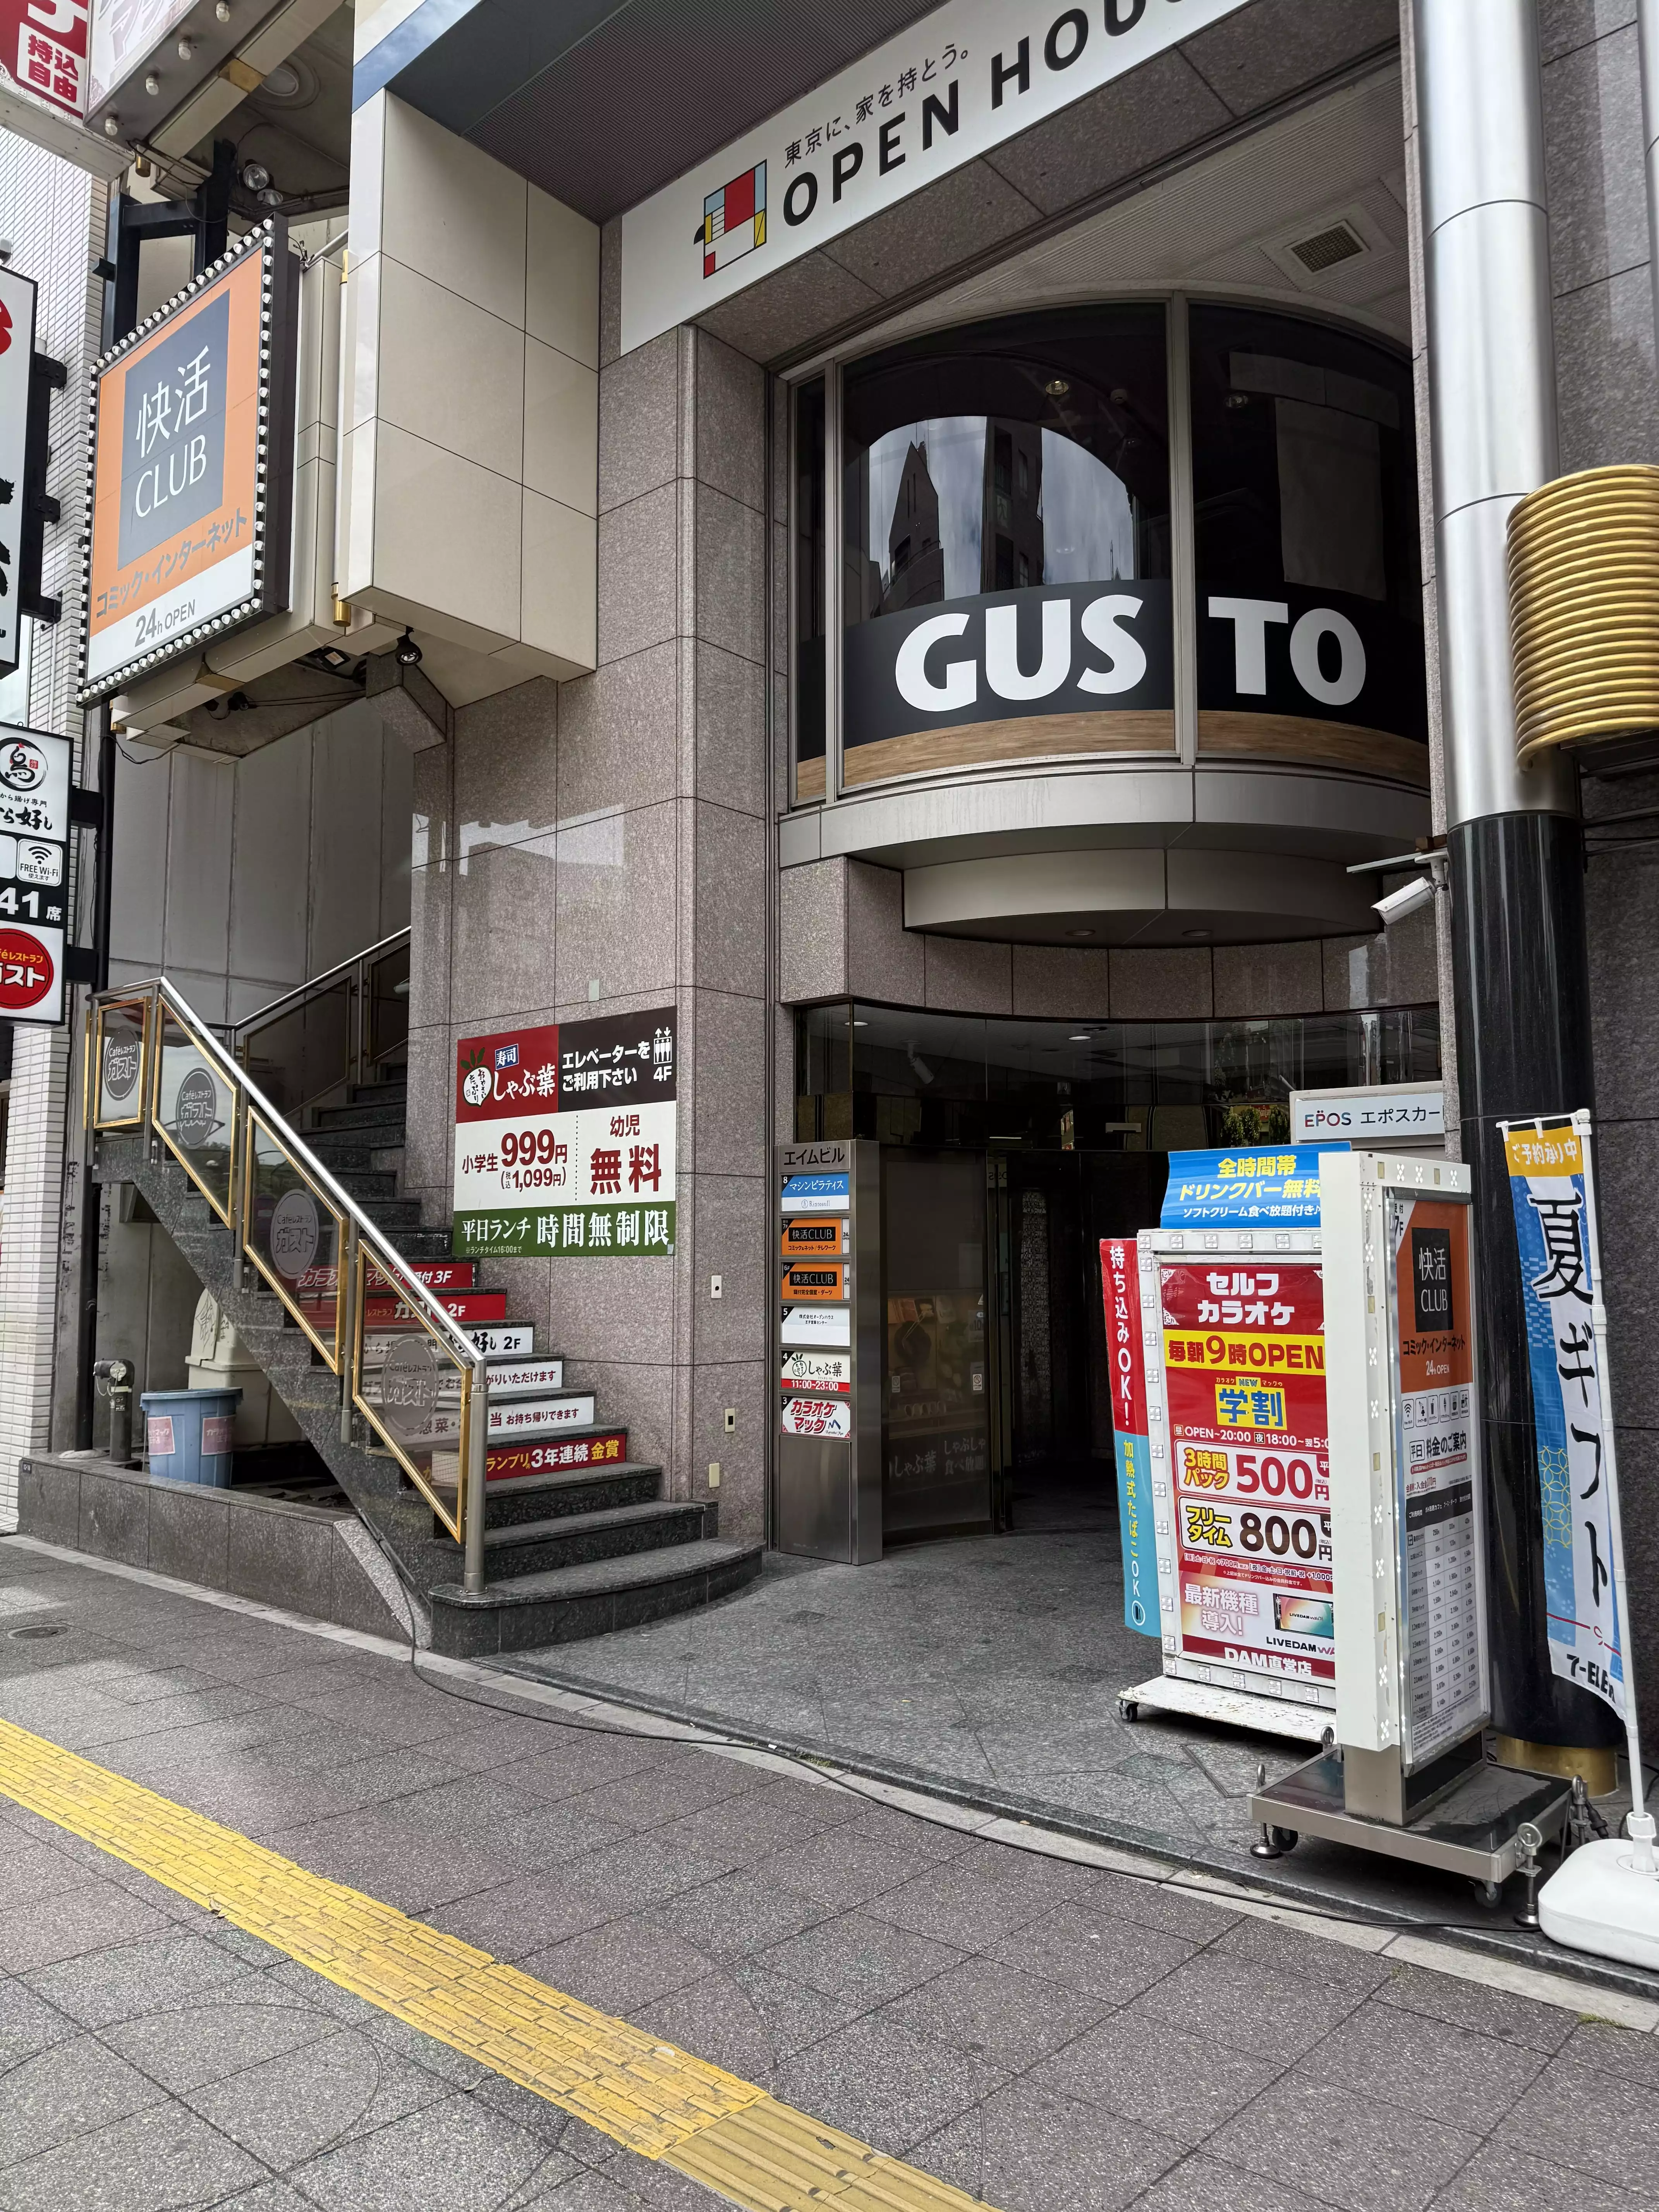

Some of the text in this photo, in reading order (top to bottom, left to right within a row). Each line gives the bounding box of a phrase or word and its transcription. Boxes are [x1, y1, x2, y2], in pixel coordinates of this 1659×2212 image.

[28, 34, 79, 81] 持込
[28, 58, 77, 103] 自由
[783, 0, 1183, 226] OPEN HOU
[135, 345, 211, 458] 快活
[135, 434, 206, 518] CLUB
[96, 507, 247, 618] コミック・インターネット
[134, 598, 195, 647] 24h OPEN
[0, 806, 52, 830] ら好し
[20, 863, 58, 877] FREE Wi-Fi
[28, 873, 50, 881] 使えます
[46, 906, 62, 921] 席
[0, 949, 43, 963] éレストラン
[496, 1047, 516, 1066] 寿司
[562, 1041, 650, 1070] エレベーターを
[108, 1056, 137, 1082] ガスト
[562, 1068, 637, 1092] ご利用下さい
[653, 1068, 672, 1082] 4F
[493, 1063, 556, 1101] しゃぶ葉
[180, 1101, 213, 1130] ガスト
[1360, 1104, 1444, 1124] エポスカー
[610, 1114, 641, 1138] 幼児
[462, 1129, 567, 1174] 小学生 999円
[783, 1147, 845, 1166] エイムビル
[1511, 1138, 1578, 1165] ご予約承り中
[590, 1143, 662, 1195] 無料
[1217, 1154, 1297, 1178] 全時間帯
[789, 1180, 844, 1191] マシンピラティス
[1179, 1178, 1321, 1201] ドリンクバー無料
[276, 1227, 314, 1253] ガスト
[461, 1209, 670, 1248] 平日ランチ 時間無制限
[792, 1229, 832, 1240] 快活CLUB
[1419, 1247, 1446, 1281] 快活
[434, 1270, 453, 1284] 3F
[793, 1273, 833, 1284] 快活CLUB
[1206, 1272, 1279, 1296] セルフ
[447, 1303, 466, 1317] 2F
[1420, 1289, 1448, 1312] CLUB
[1197, 1300, 1295, 1326] カラオケ
[503, 1336, 521, 1350] 2F
[1403, 1334, 1466, 1356] コミック・インターネット
[783, 1352, 788, 1360] 4
[809, 1360, 842, 1377] しゃぶ葉
[1426, 1360, 1450, 1376] 24h OPEN
[1239, 1378, 1258, 1387] NEW
[782, 1396, 787, 1405] 3
[790, 1400, 837, 1418] カラオケ
[1219, 1388, 1284, 1427] 学割
[1530, 1191, 1608, 1608] 夏ギフト
[506, 1408, 579, 1425] お持ち帰りできます
[793, 1417, 827, 1434] マック
[591, 1439, 619, 1460] 金賞
[1411, 1430, 1467, 1459] 平日 料金のご案内
[1184, 1448, 1227, 1470] 3時間
[1185, 1468, 1229, 1490] パック
[1186, 1506, 1231, 1526] フリー
[1187, 1525, 1233, 1548] タイム
[1184, 1583, 1258, 1615] 最新機種
[1202, 1610, 1243, 1636] 導入!
[1266, 1636, 1317, 1652] LIVEDAM
[1224, 1647, 1312, 1676] DAM直営店
